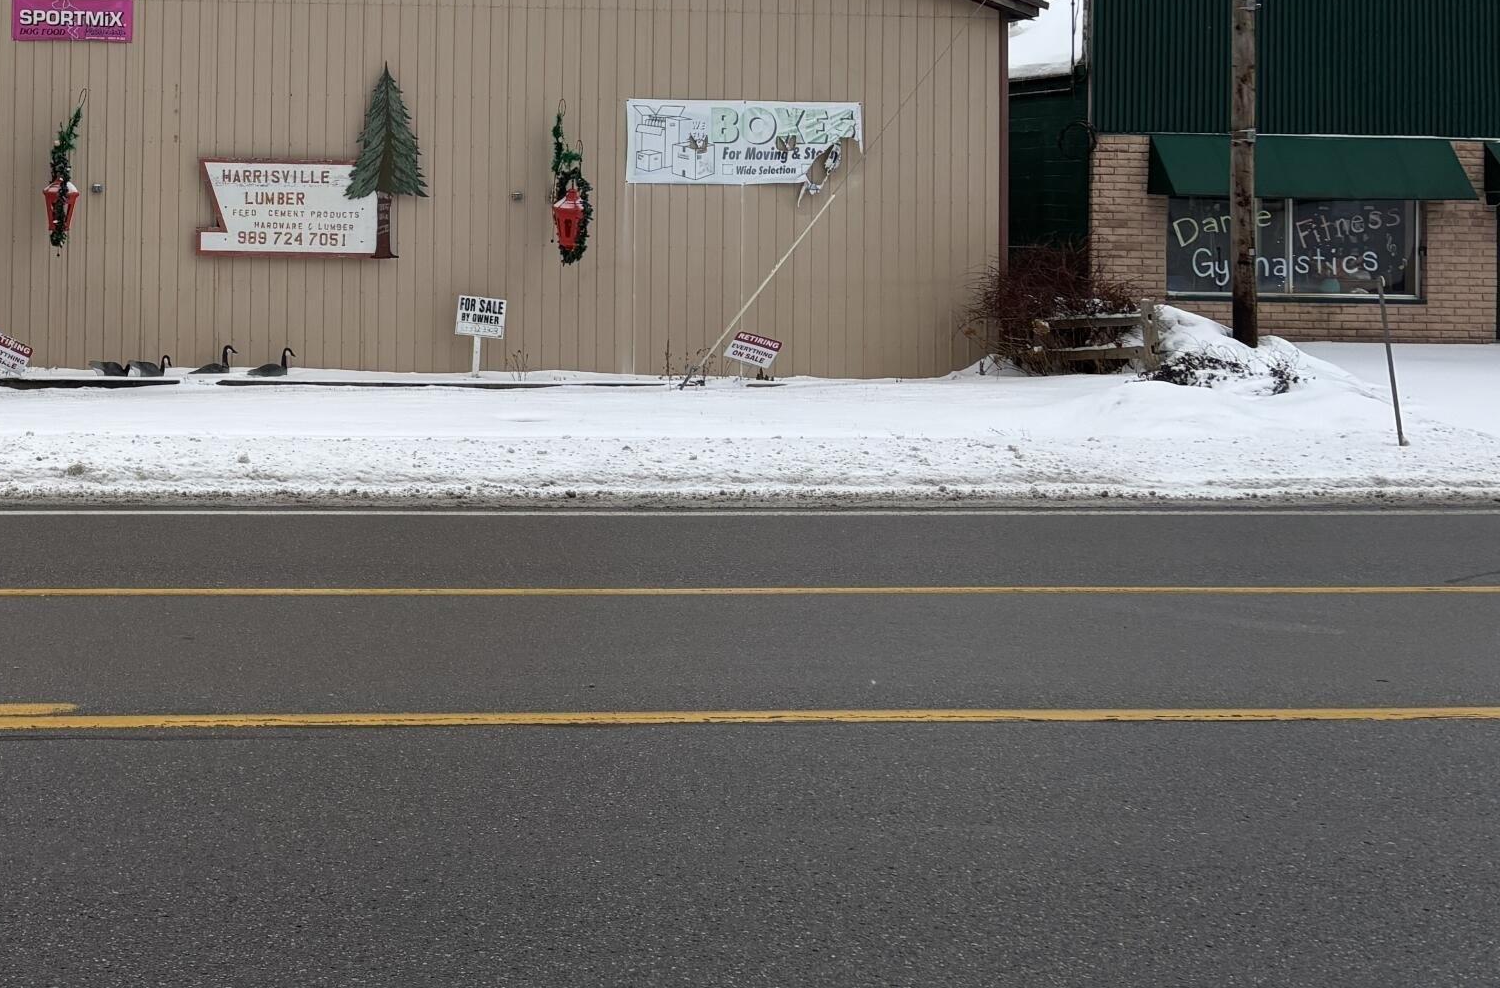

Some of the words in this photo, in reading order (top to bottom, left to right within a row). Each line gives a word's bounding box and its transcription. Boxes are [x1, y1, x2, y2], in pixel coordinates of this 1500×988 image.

[19, 27, 39, 35] DOG
[41, 27, 66, 36] FOOD
[722, 147, 742, 160] For
[744, 147, 788, 163] Moving
[221, 169, 331, 184] HARRISVILLE
[735, 165, 756, 175] Wide
[758, 165, 797, 176] Selection
[244, 192, 306, 206] LUMBER
[232, 209, 257, 218] FEED
[268, 209, 305, 218] CEMENT
[310, 210, 360, 219] PRODUCTS
[254, 222, 303, 231] HARDWARE
[317, 223, 354, 231] LUMBER
[1294, 207, 1401, 249] Fitness
[237, 231, 267, 245] 989
[273, 232, 303, 246] 724
[308, 233, 347, 247] 7051
[1192, 247, 1379, 286] Gynastics
[460, 297, 476, 312] FOR
[479, 299, 504, 315] SALE
[461, 312, 470, 322] BY
[472, 313, 499, 325] OWNER
[737, 332, 780, 349] RETIRING
[731, 343, 773, 359] EVERYTHING
[732, 350, 744, 358] ON
[744, 353, 765, 364] SALE
